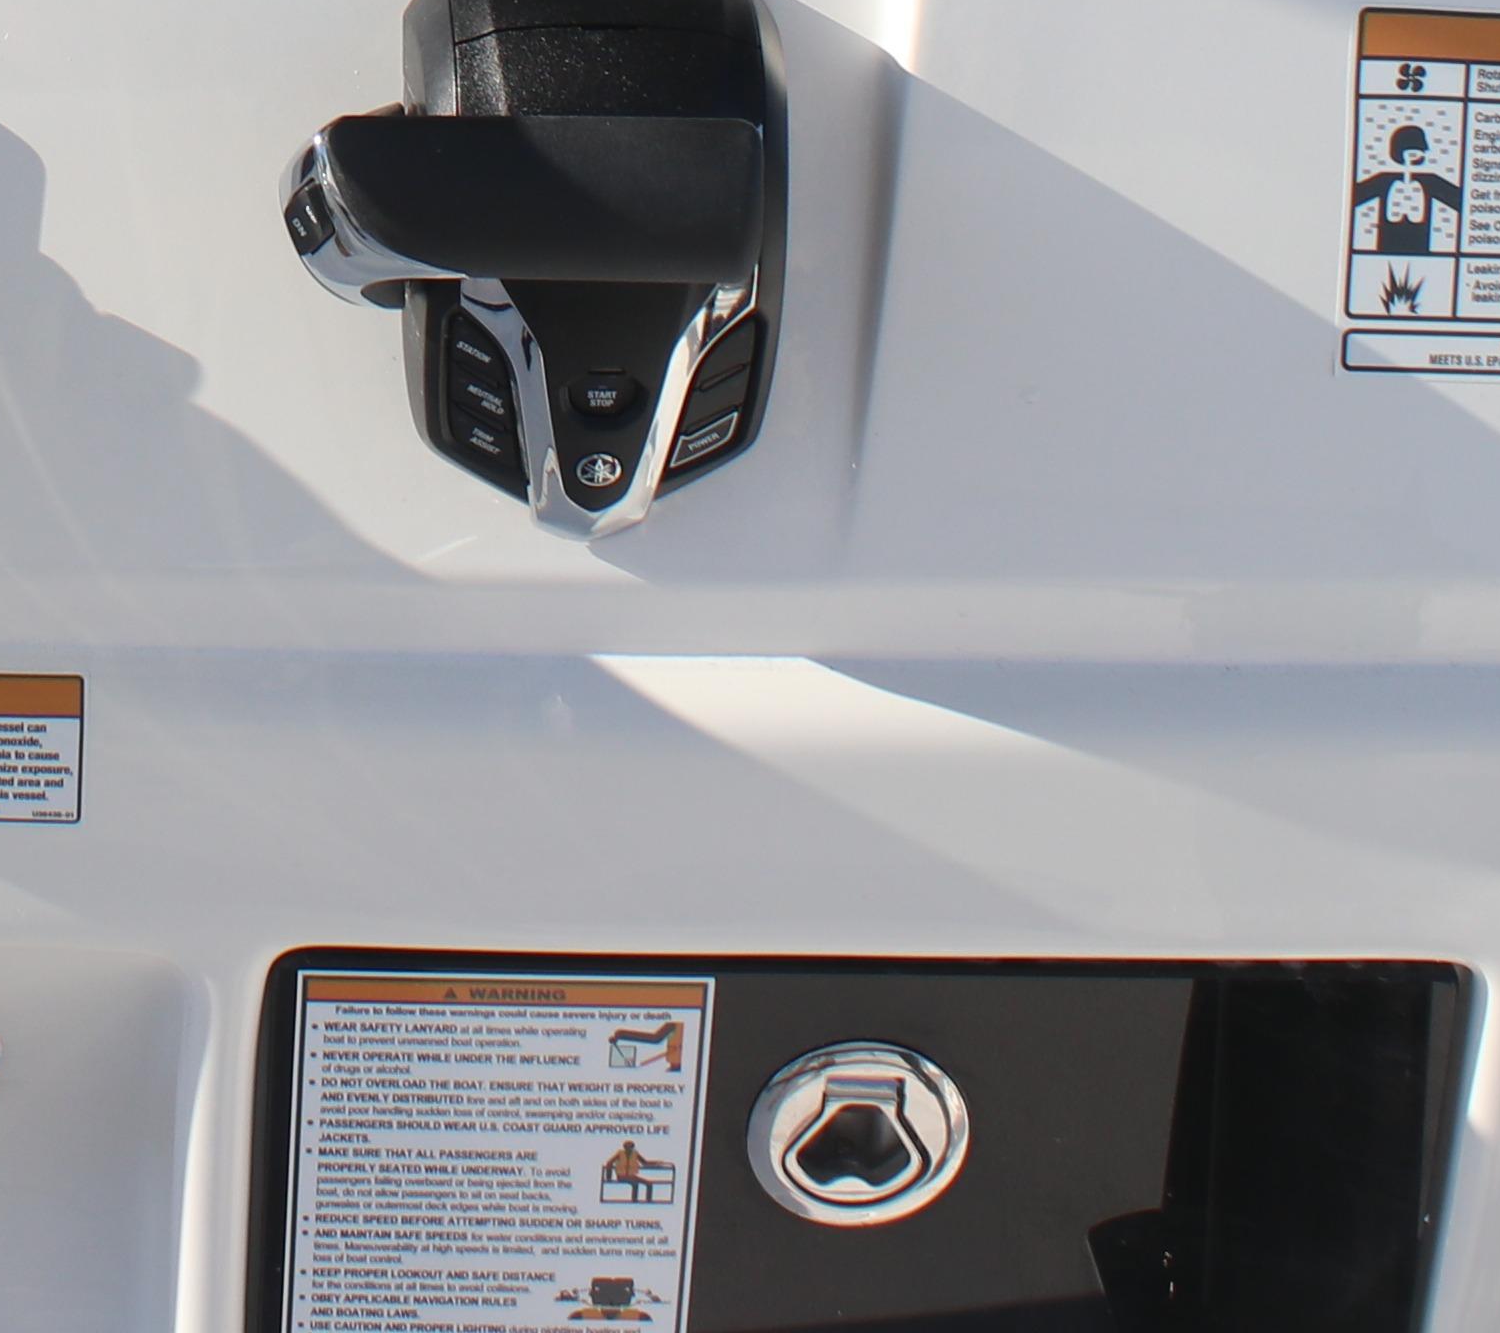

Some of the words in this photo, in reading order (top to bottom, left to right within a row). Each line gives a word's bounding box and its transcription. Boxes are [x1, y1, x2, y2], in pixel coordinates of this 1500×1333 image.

[456, 340, 492, 363] STATION
[1428, 354, 1462, 367] MEETS
[1465, 355, 1483, 367] U.S.
[466, 384, 503, 405] NEUTRAL
[587, 390, 617, 400] START
[481, 399, 505, 415] HOLD
[589, 399, 614, 407] STOP
[688, 432, 720, 452] POWER
[469, 987, 567, 1001] WARNING
[322, 1051, 360, 1062] NEVER
[362, 1051, 414, 1063] OPERATE
[416, 1052, 451, 1064] WHILE
[454, 1053, 492, 1064] UNDER
[496, 1054, 516, 1064] THE
[519, 1054, 580, 1065] INFLUENCE
